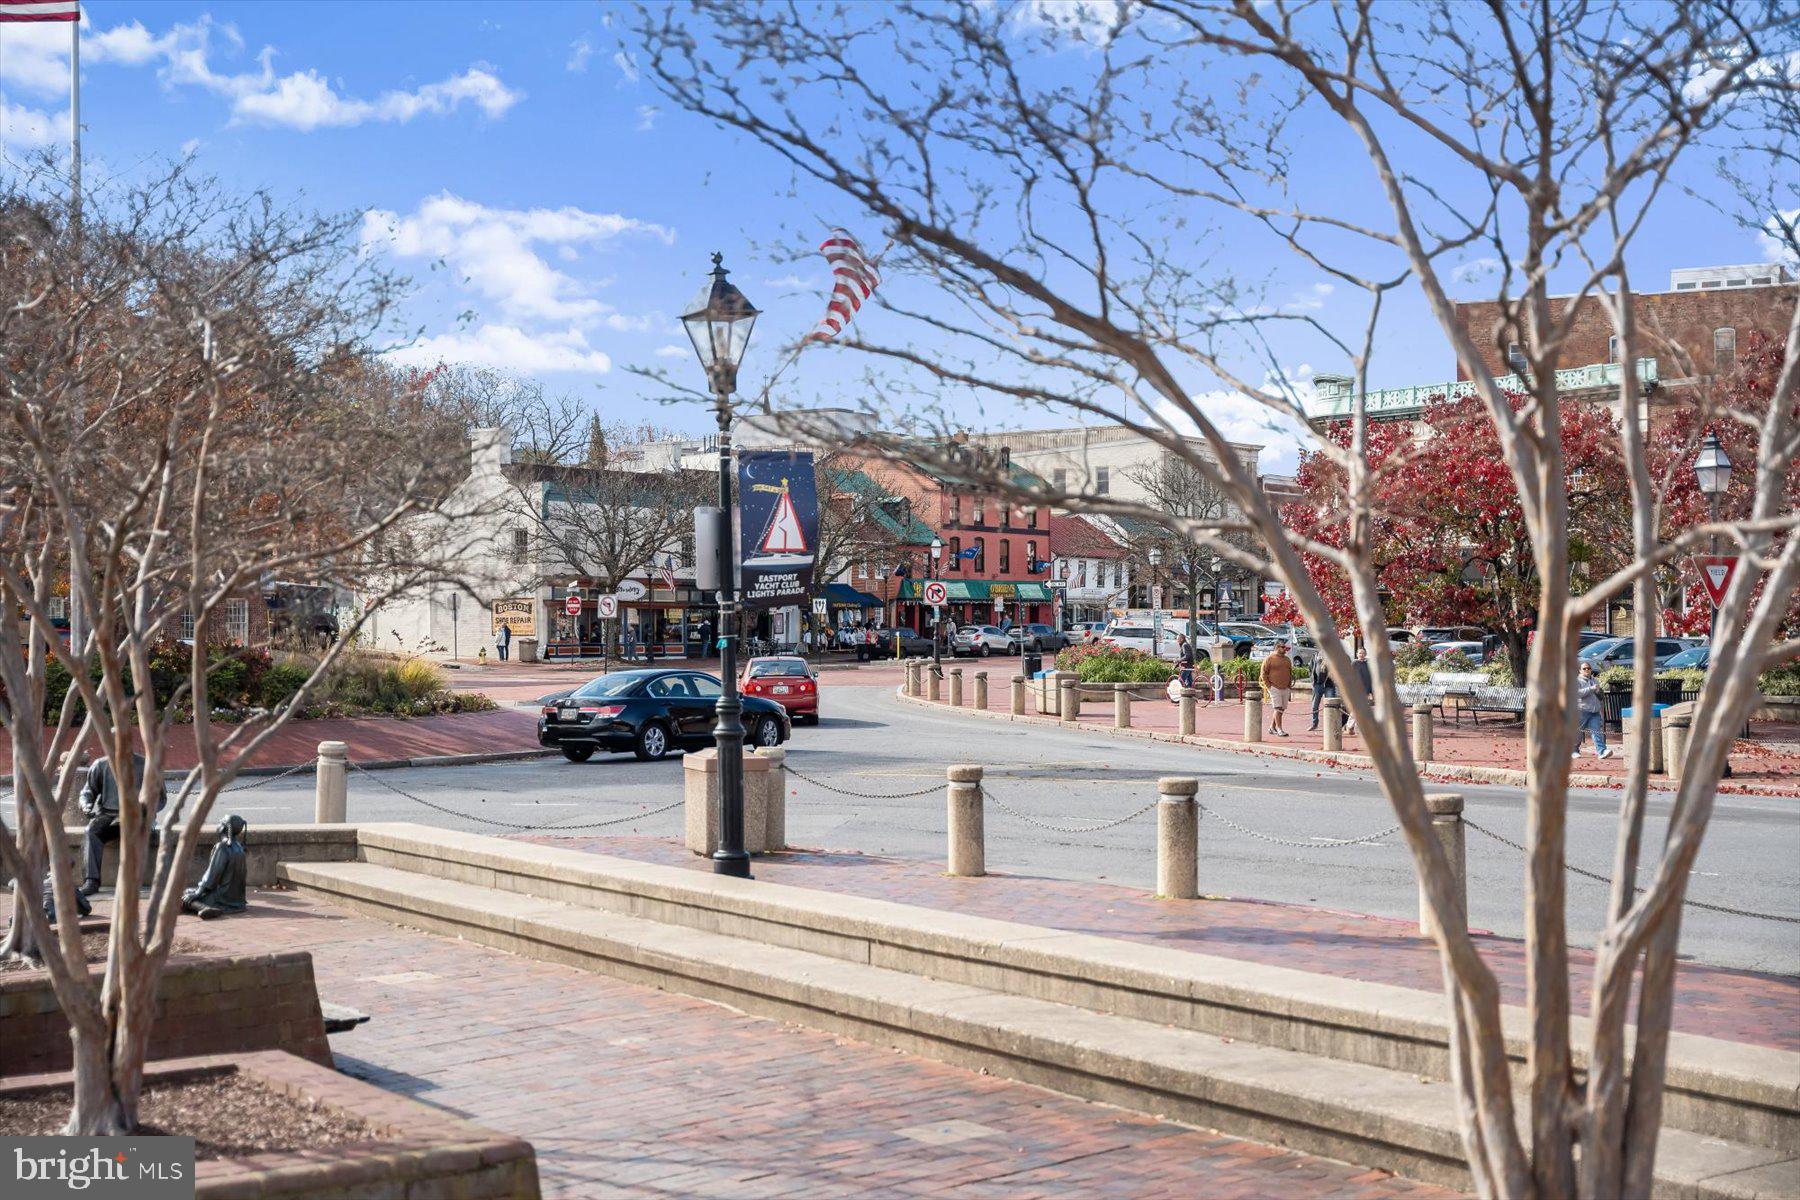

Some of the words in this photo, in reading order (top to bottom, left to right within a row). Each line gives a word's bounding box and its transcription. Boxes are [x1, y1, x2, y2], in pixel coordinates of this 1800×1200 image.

[758, 573, 798, 582] EASTPORT
[754, 582, 780, 590] YACHT
[781, 580, 800, 589] CLUB
[747, 590, 775, 598] LIGHTS
[776, 586, 805, 596] PARADE
[498, 603, 530, 612] BOSTON
